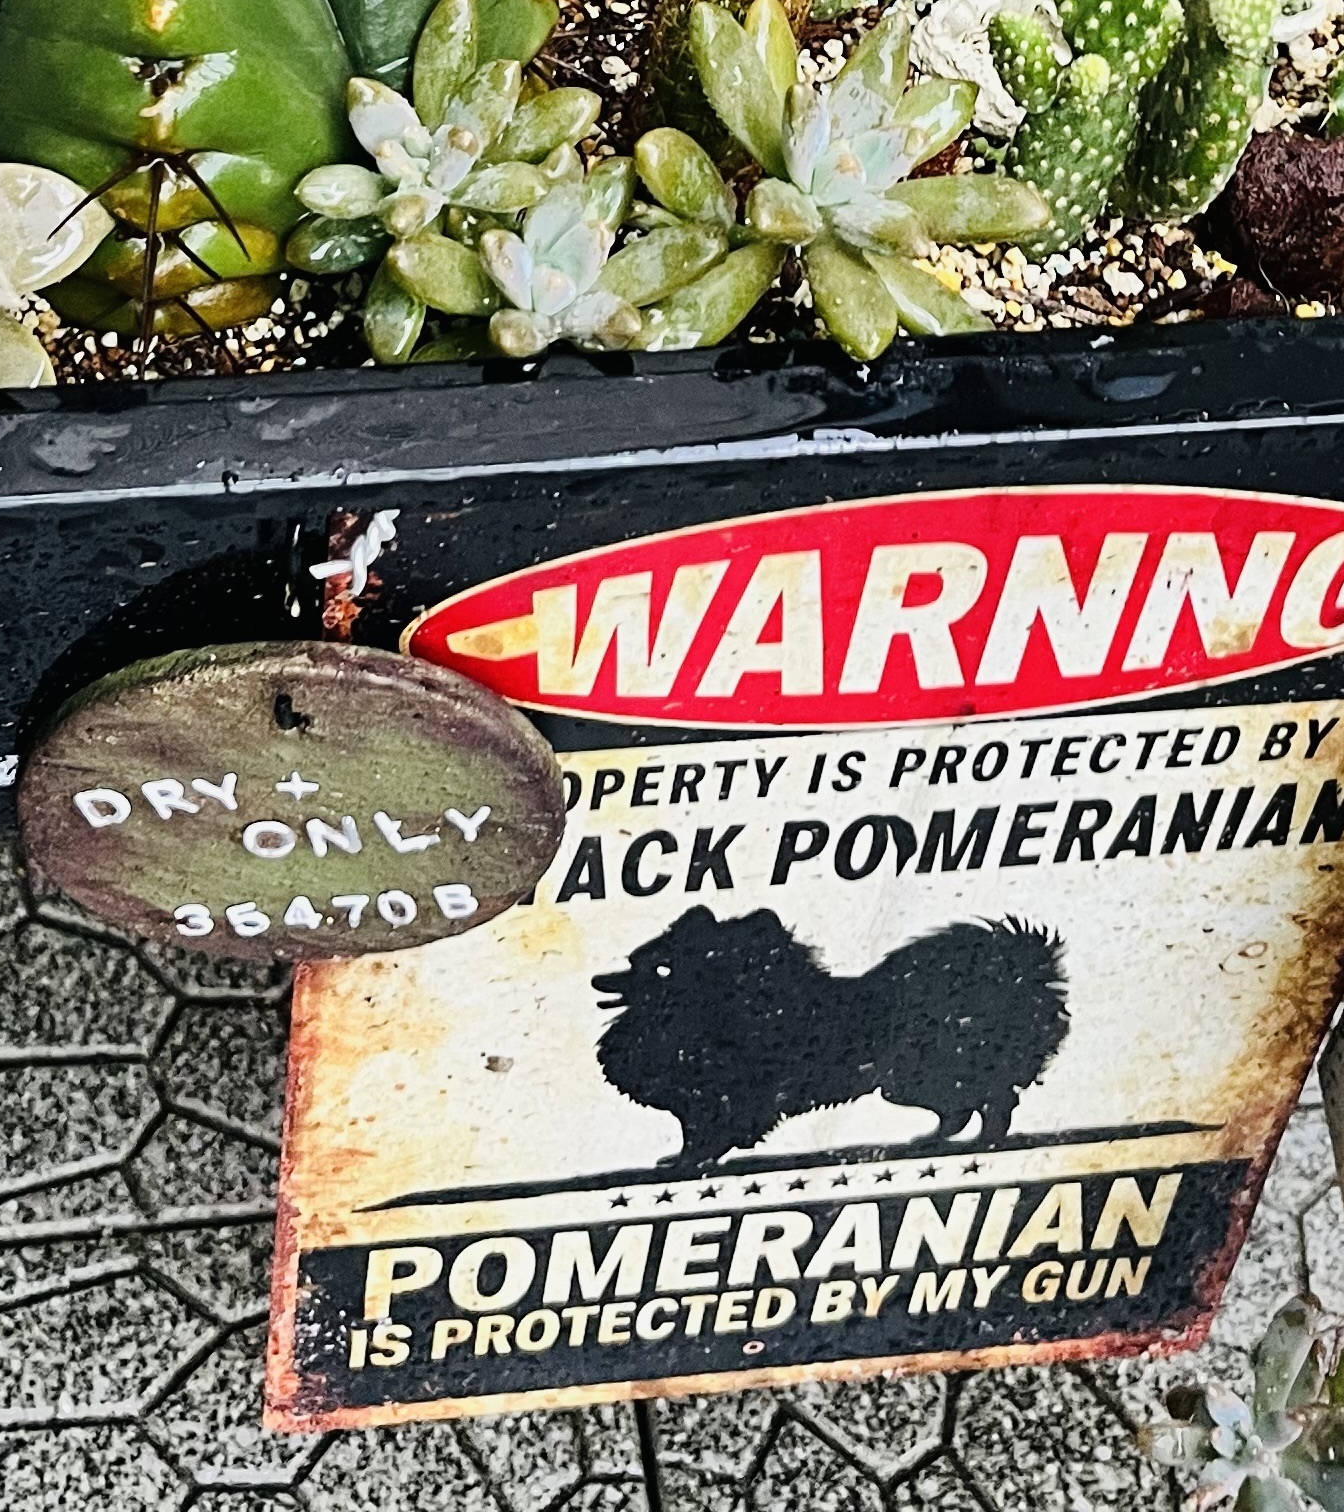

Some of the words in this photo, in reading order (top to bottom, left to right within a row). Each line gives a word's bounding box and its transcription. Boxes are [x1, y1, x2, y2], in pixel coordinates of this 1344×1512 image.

[807, 750, 867, 794] IS
[888, 724, 1242, 788] PROTECTED
[1259, 717, 1340, 763] BY
[72, 772, 239, 829] DRY
[243, 805, 492, 859] ONLY
[516, 823, 747, 906] ACK
[362, 1172, 1184, 1322] POMERANIAN
[348, 1324, 413, 1369] IS
[430, 1286, 798, 1361] PROTECTED
[810, 1274, 900, 1324] BY
[907, 1264, 1011, 1315] MY
[1021, 1256, 1153, 1304] GUN
